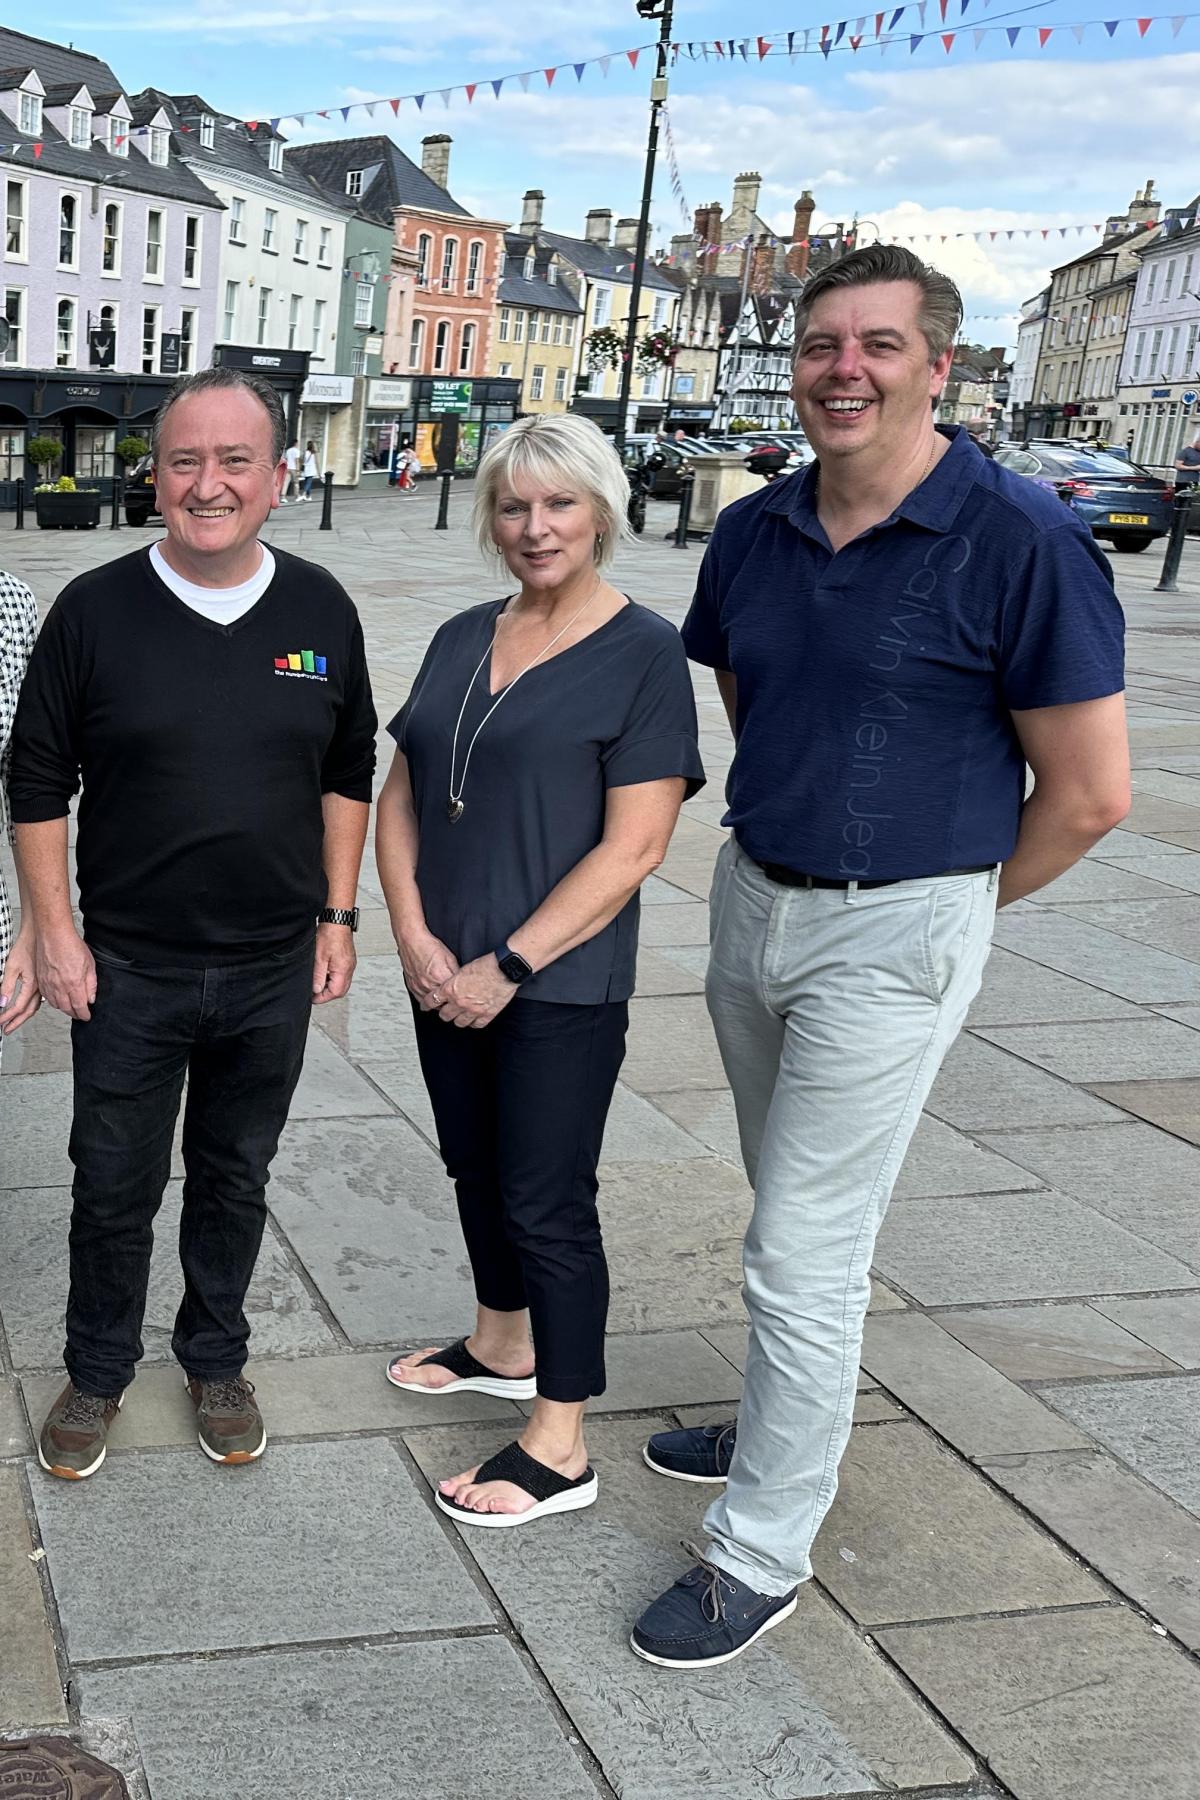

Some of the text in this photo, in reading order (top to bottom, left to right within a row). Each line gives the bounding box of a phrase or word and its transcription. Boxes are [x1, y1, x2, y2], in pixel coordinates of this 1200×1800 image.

[433, 381, 460, 390] TO LET
[868, 534, 971, 672] Calvin
[850, 683, 908, 789] Klein
